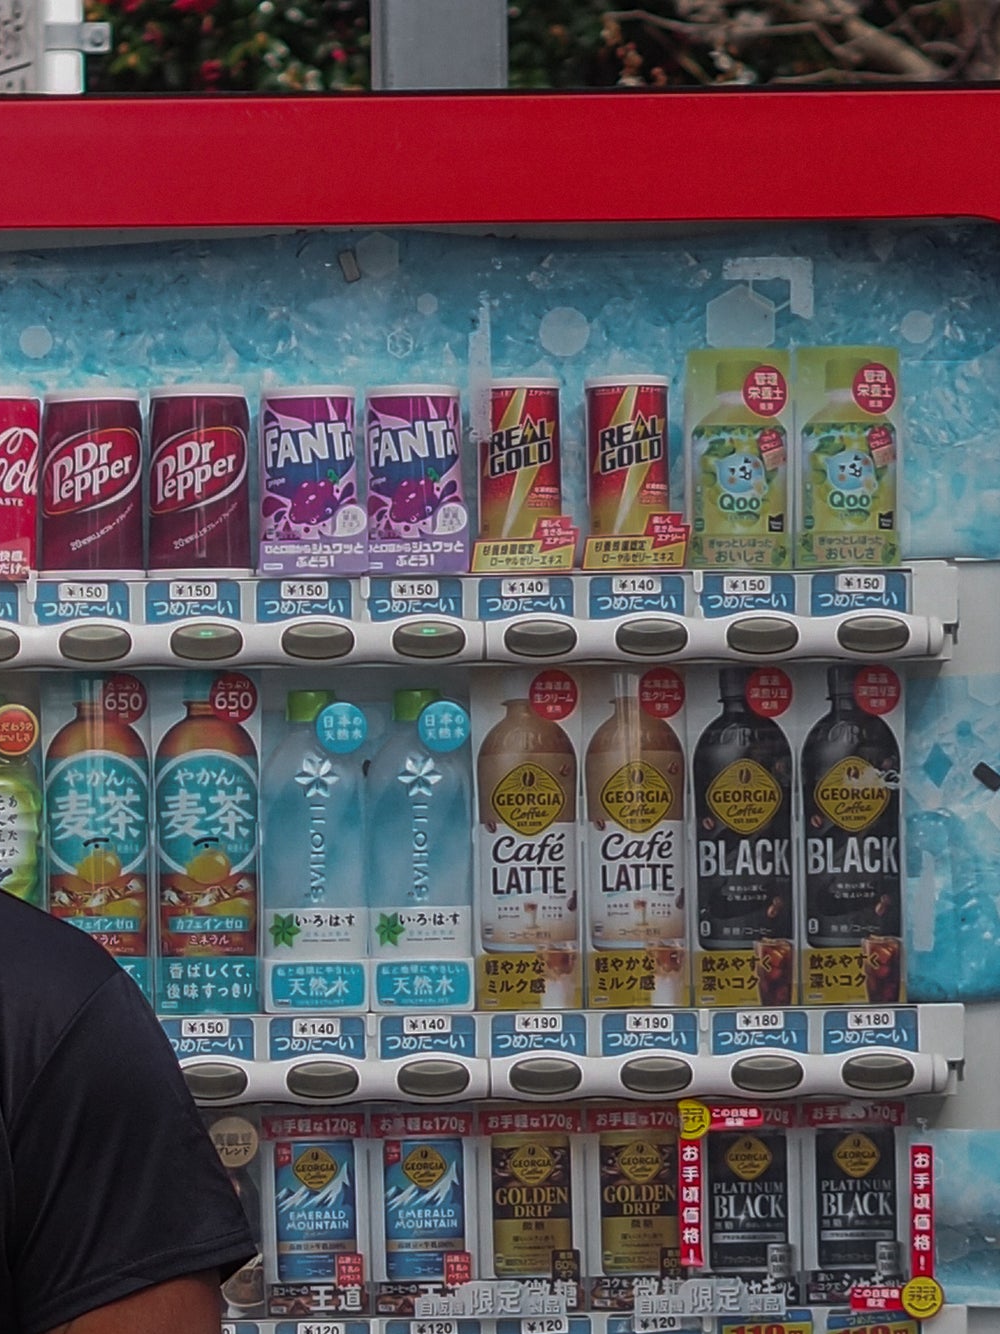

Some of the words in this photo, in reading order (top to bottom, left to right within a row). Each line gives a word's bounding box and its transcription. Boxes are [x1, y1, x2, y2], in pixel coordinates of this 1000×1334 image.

[490, 414, 551, 455] REAL
[600, 410, 662, 451] REAL
[369, 421, 458, 467] FANTA
[74, 442, 112, 474] Dr
[177, 440, 215, 473] Dr
[490, 441, 552, 477] GOLD
[600, 438, 663, 474] GOLD
[53, 455, 132, 505] Pepper
[157, 454, 236, 504] Pepper
[718, 493, 761, 512] Qoo
[828, 491, 871, 509] Qoo
[508, 581, 544, 593] ¥140
[104, 693, 143, 711] 650
[214, 692, 253, 710] 650
[324, 716, 362, 728] 日本の
[497, 793, 562, 806] GEORGIA
[605, 790, 670, 804] GEORGIA
[712, 790, 777, 803] GEORGIA
[820, 788, 885, 801] GEORGIA
[51, 788, 145, 841] 麦茶
[160, 787, 254, 840] 麦茶
[510, 807, 549, 820] Coffee
[492, 833, 566, 865] Café
[601, 830, 674, 862] Café
[699, 839, 790, 877] BLACK
[807, 836, 898, 874] BLACK
[492, 865, 567, 895] LATTE
[601, 863, 675, 893] LATTE
[189, 934, 229, 945] ミネラル
[485, 959, 545, 976] 軽やかな
[702, 955, 772, 973] 飲みやすく
[167, 983, 253, 1000] 後味すっきり
[289, 977, 350, 997] 天然水
[393, 976, 455, 995] 天然水
[488, 979, 546, 994] ミルク感
[702, 975, 760, 992] 深いコク
[188, 1022, 224, 1033] ¥150
[408, 1018, 445, 1031] ¥140
[521, 1017, 557, 1029] ¥190
[632, 1017, 669, 1028] ¥190
[742, 1015, 778, 1026] ¥180
[854, 1014, 889, 1025] ¥180
[298, 1023, 334, 1034] ¥140
[603, 1184, 676, 1203] GOLDEN
[713, 1182, 784, 1194] PLATINUM
[821, 1180, 892, 1192] PLATINUM
[495, 1186, 569, 1205] GOLDEN
[821, 1191, 893, 1217] BLACK
[289, 1210, 346, 1220] EMERALD
[398, 1208, 455, 1219] EMERALD
[513, 1205, 552, 1218] DRIP
[622, 1203, 660, 1215] DRIP
[713, 1193, 785, 1220] BLACK
[286, 1219, 349, 1230] MOUNTAIN
[394, 1218, 457, 1229] MOUNTAIN
[310, 1284, 362, 1311] 王道
[417, 1323, 452, 1334] ¥120
[527, 1319, 563, 1332] ¥120
[640, 1316, 676, 1329] ¥120
